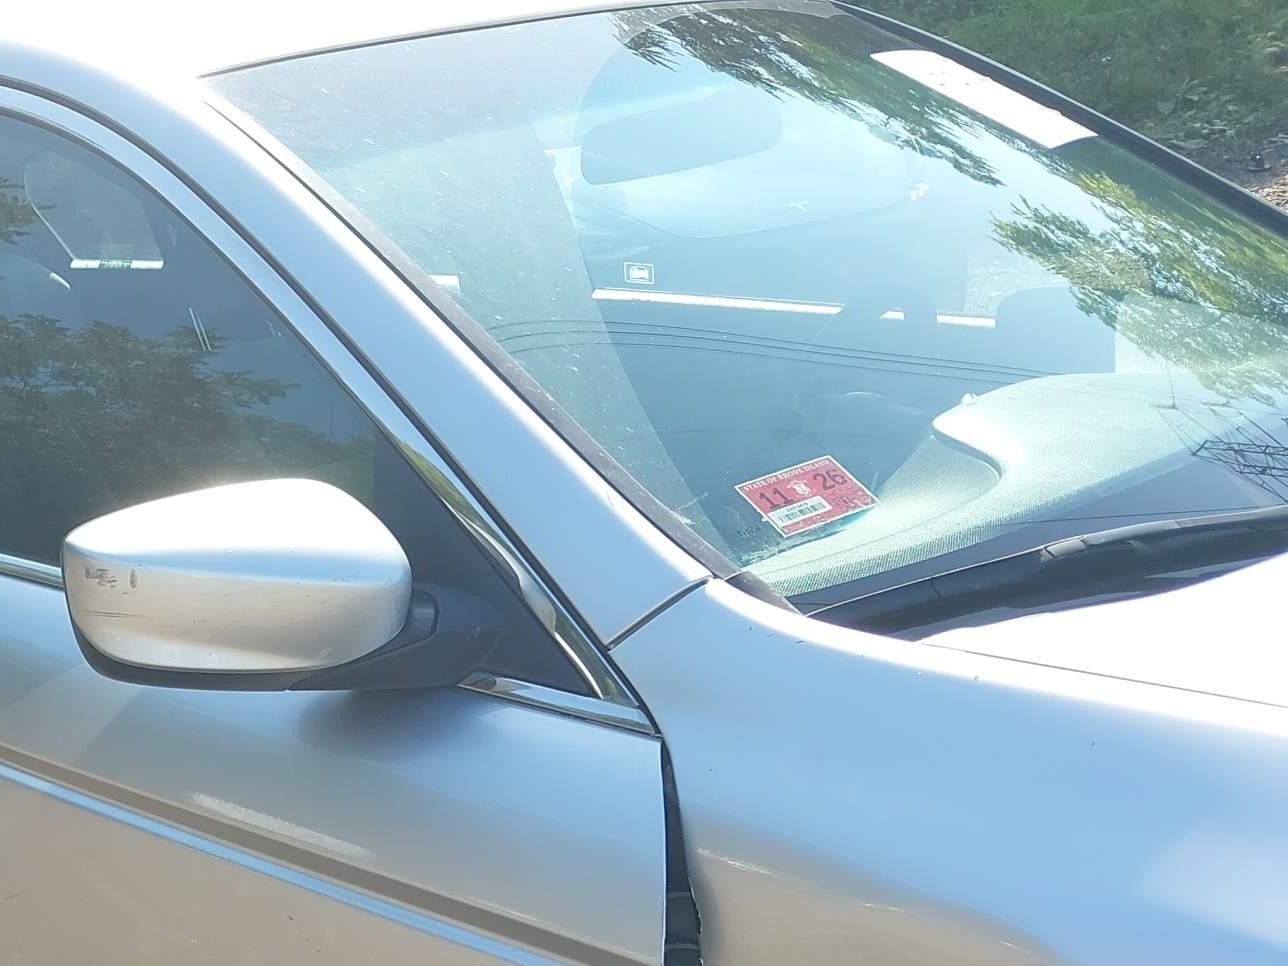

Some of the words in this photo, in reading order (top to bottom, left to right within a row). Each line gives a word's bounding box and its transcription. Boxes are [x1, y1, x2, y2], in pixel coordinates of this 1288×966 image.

[743, 480, 768, 492] STATE
[777, 467, 806, 480] RHODE
[803, 459, 829, 472] ISLAND
[759, 487, 794, 510] 11
[813, 468, 848, 490] 26
